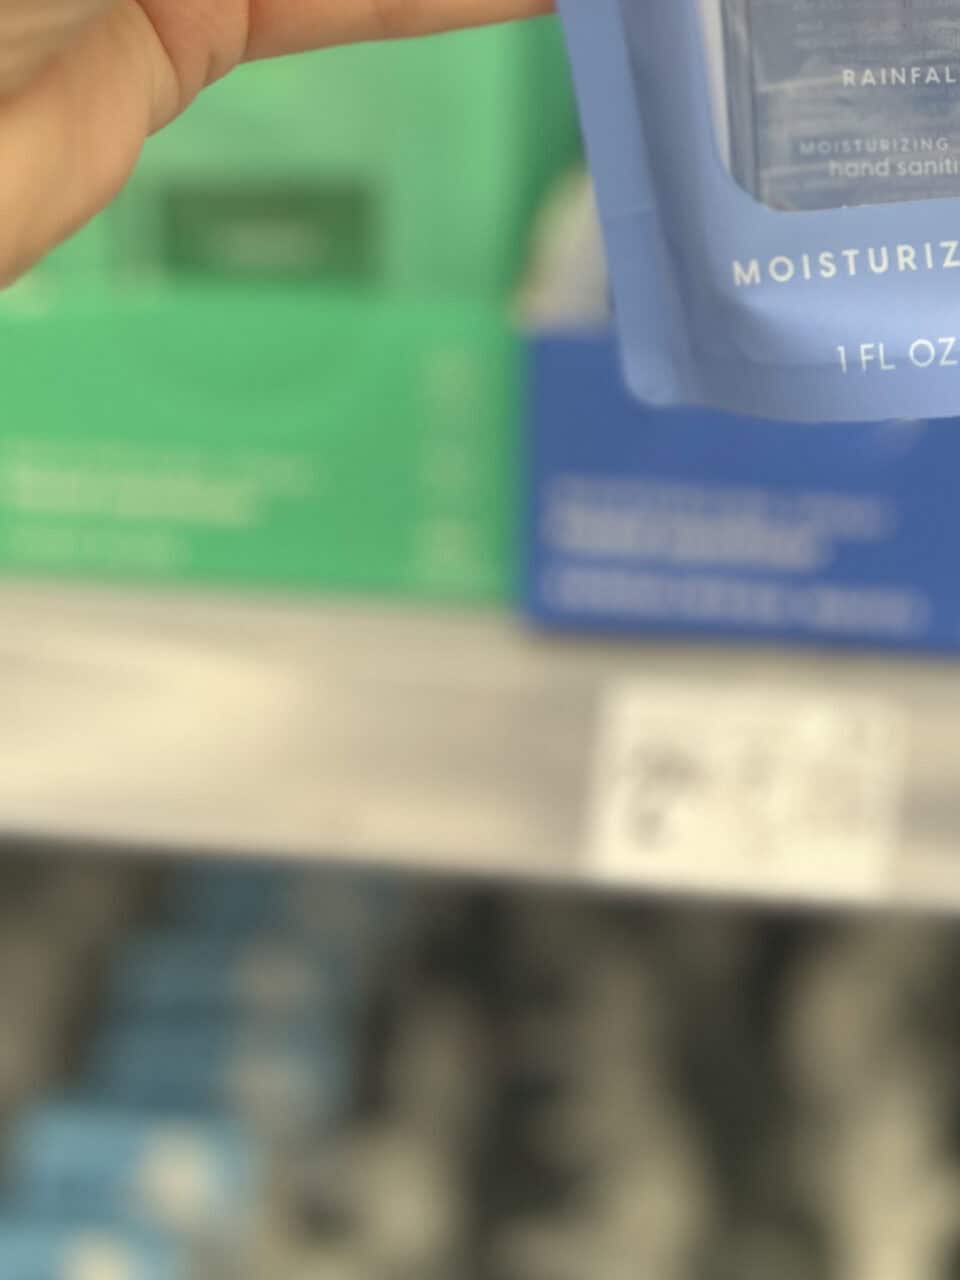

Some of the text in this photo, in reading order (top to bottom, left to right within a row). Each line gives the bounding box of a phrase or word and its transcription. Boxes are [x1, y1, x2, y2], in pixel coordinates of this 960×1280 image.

[801, 135, 949, 154] MOISTURIZING
[830, 157, 889, 177] hand
[837, 345, 848, 374] 1
[861, 342, 896, 373] FL
[909, 336, 959, 368] OZ
